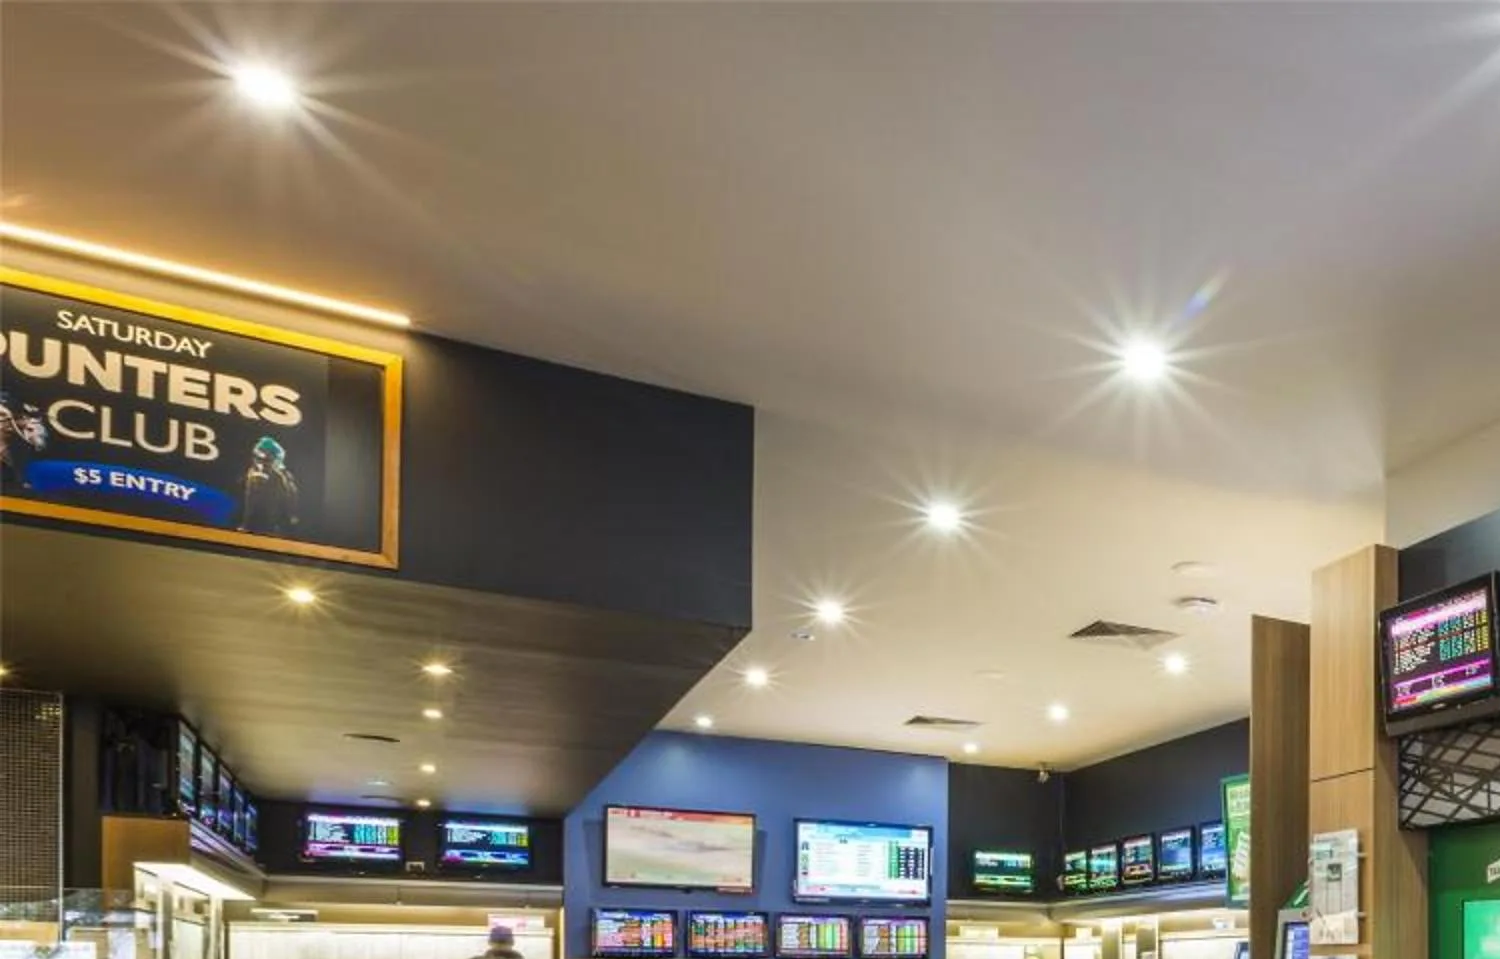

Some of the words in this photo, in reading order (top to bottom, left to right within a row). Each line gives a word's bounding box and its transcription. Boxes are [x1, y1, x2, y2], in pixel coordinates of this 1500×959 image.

[56, 310, 213, 359] SATURDAY
[0, 330, 302, 426] UNTERS
[47, 399, 220, 461] CLUB
[73, 467, 102, 485] $5
[109, 472, 197, 501] ENTRY
